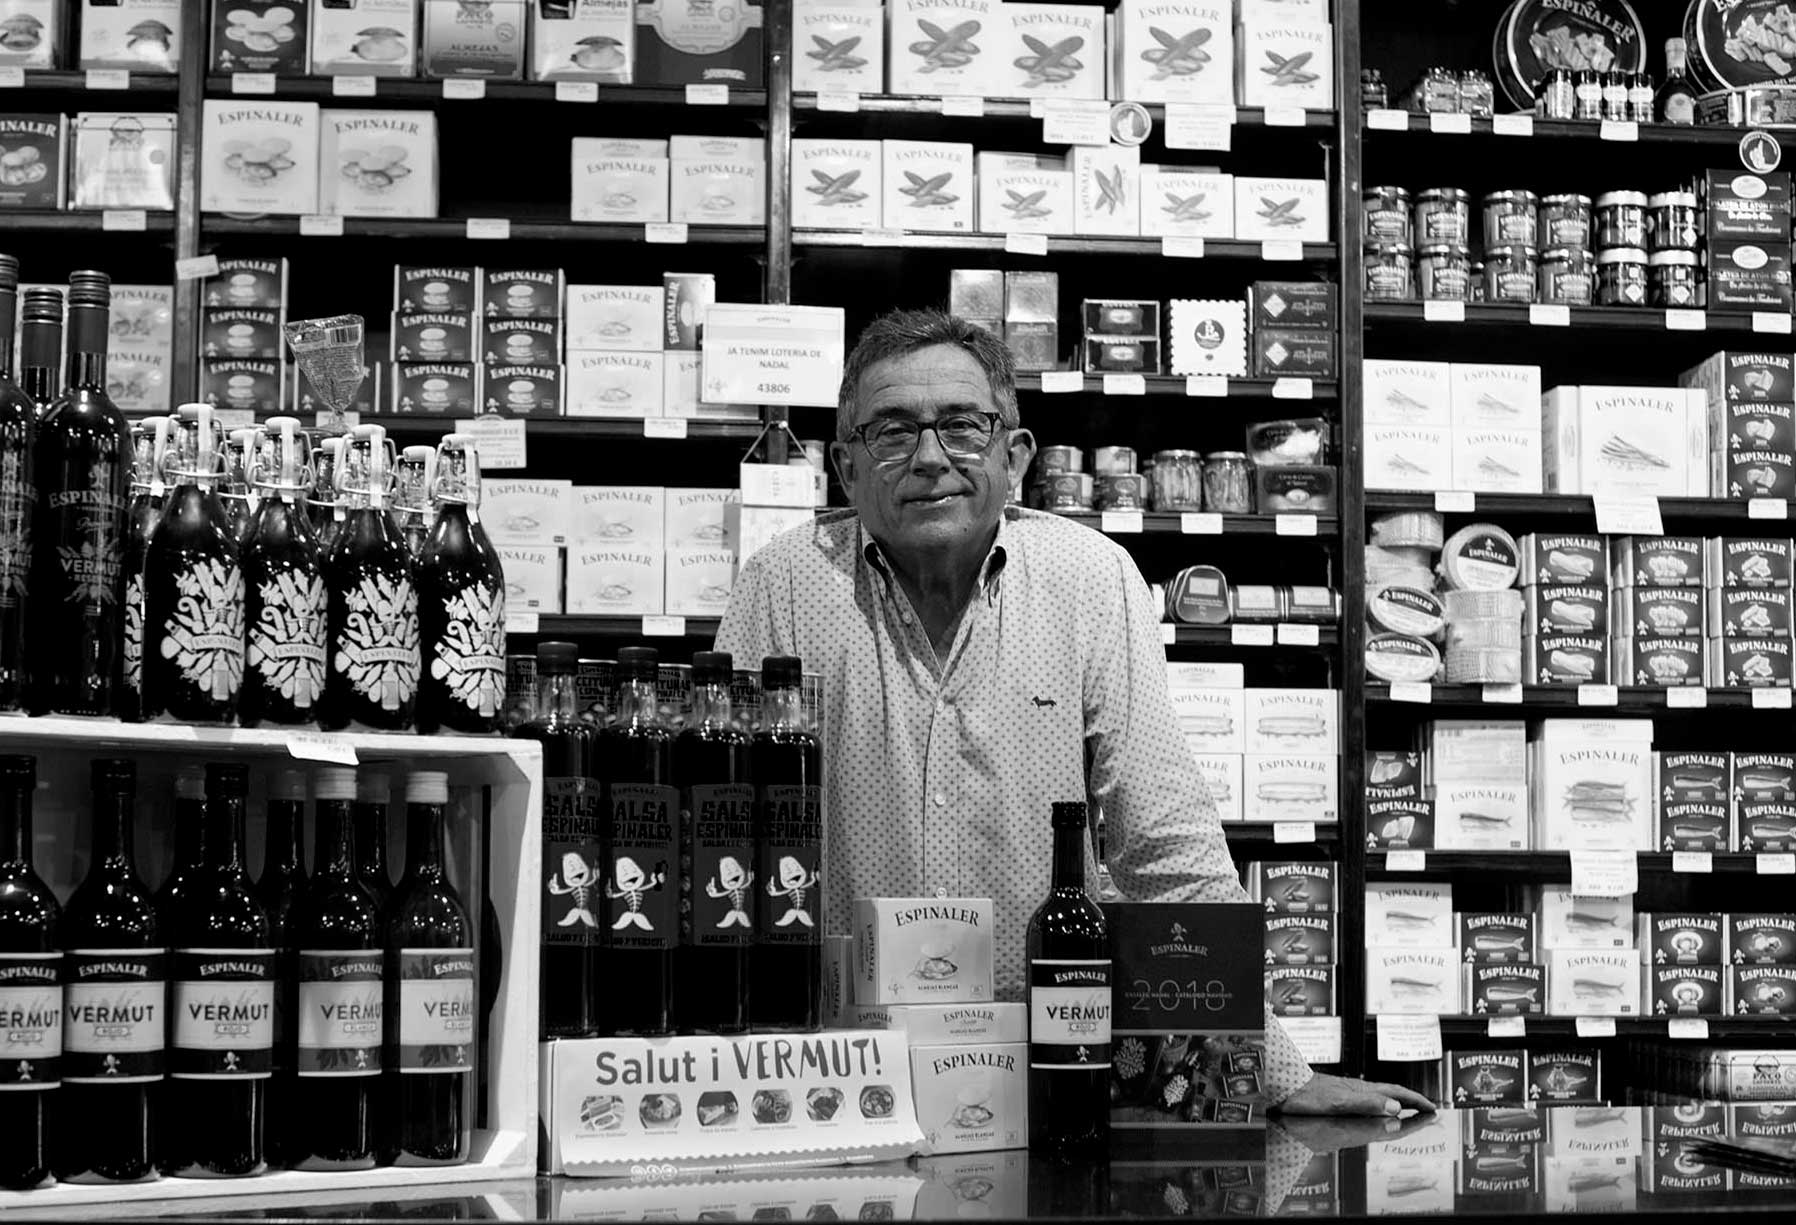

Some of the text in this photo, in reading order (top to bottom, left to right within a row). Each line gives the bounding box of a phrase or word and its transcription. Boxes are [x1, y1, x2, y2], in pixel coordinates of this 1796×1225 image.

[802, 13, 873, 29] ESPINALER
[1011, 12, 1093, 31] ESPINALER
[1138, 6, 1221, 23] ESPINALER
[1256, 28, 1324, 42] ESPINALER
[217, 110, 304, 128] ESPINALER
[0, 120, 57, 138] INALER
[333, 120, 420, 136] ESPINALER
[802, 147, 873, 161] ESPINALER
[894, 149, 964, 164] ESPINALER
[586, 160, 657, 177] ESPINALER
[683, 161, 756, 178] ESPINALER
[404, 269, 471, 282] ESPINALER
[489, 270, 554, 285] ESPINALER
[581, 289, 653, 303] ESPINALER
[210, 308, 276, 324] ESPINALER
[668, 281, 680, 345] ESPINALER
[401, 314, 467, 328] ESPINALER
[489, 320, 554, 334] ESPINALER
[728, 347, 821, 358] JA TENIM LOTERIA DE
[210, 360, 276, 375] ESPINALER
[581, 356, 653, 371] ESPINALER
[759, 361, 790, 369] NADAL
[1730, 354, 1790, 369] ESPINALER
[403, 365, 470, 379] ESPINALER
[490, 366, 556, 380] ESPINALER
[1374, 367, 1438, 381] ESPINALER
[1463, 369, 1529, 384] ESPINALER
[757, 383, 791, 393] 43806
[1594, 398, 1675, 414] ESPINALER
[1732, 403, 1791, 419] ESPINALER
[1374, 430, 1440, 445] ESPINALER
[1466, 433, 1529, 448] ESPINALER
[1733, 451, 1793, 467] ESPINALER
[488, 483, 560, 498] ESPINALER
[583, 490, 653, 505] ESPINALER
[678, 493, 738, 506] ESPINAL
[1540, 537, 1602, 553] ESPINALER
[1638, 539, 1699, 554] ESPINALER
[1728, 542, 1787, 556] ESPINALER
[580, 552, 653, 567] ESPINALER
[680, 554, 739, 568] ESPINAL
[1468, 548, 1509, 564] ESPINALER
[60, 558, 122, 576] VERMUT
[1541, 587, 1603, 601] ESPINALER
[1639, 588, 1699, 603] ESPINALER
[1726, 592, 1787, 605] ESPINALER
[1391, 591, 1434, 613] ESPINALER
[1377, 639, 1424, 653] ESPINALER
[1541, 636, 1603, 652] ESPINALER
[1638, 638, 1699, 654] ESPINALER
[1729, 641, 1788, 656] ESPINALER
[1174, 694, 1231, 707] SPINALER
[1259, 695, 1324, 708] ESPINALER
[1559, 749, 1639, 766] ESPINALER
[1665, 754, 1725, 768] ESPINALER
[1735, 756, 1794, 768] ESPINALER
[1257, 760, 1326, 773] ESPINALER
[1450, 790, 1517, 803] ESPINALER
[612, 800, 668, 823] ALSA
[1369, 801, 1430, 815] ESPINALER
[1666, 804, 1726, 818] ESPINALER
[1743, 804, 1796, 818] ESPINALE
[612, 823, 672, 841] PINALER
[1266, 864, 1329, 879] ESPINALER
[1378, 888, 1440, 901] ESPINALER
[894, 906, 979, 927] ESPINALER
[1265, 916, 1329, 931] ESPINALER
[1466, 914, 1528, 929] ESPINALER
[1735, 917, 1794, 931] ESPINALER
[1658, 917, 1719, 932] ESPINALER
[1150, 942, 1209, 956] ESPINALER
[1382, 954, 1446, 968] ESPINALER
[1566, 953, 1628, 968] ESPINALER
[0, 968, 57, 981] SPINALER
[78, 963, 148, 977] ESPINALER
[200, 962, 266, 977] ESPINALER
[331, 963, 382, 977] ESPINALE
[1054, 970, 1106, 983] ESPINALER
[1271, 967, 1328, 982] SPINALER
[1478, 966, 1541, 981] ESPINALER
[1658, 967, 1718, 982] ESPINALER
[1132, 979, 1225, 1011] 2018
[70, 1005, 154, 1023] VERMUT
[189, 1003, 270, 1021] VERMUT
[424, 1002, 472, 1017] VERM
[943, 1008, 995, 1023] ESPINALER
[1046, 1006, 1109, 1019] VERMUT
[0, 1010, 59, 1028] ERMUT
[858, 1012, 893, 1024] ESPINALER
[596, 1038, 882, 1086] Salut i VERMUT!
[933, 1052, 1015, 1075] ESPINALER
[1457, 1054, 1520, 1069] ESPINALER
[1532, 1053, 1593, 1068] ESPINALER
